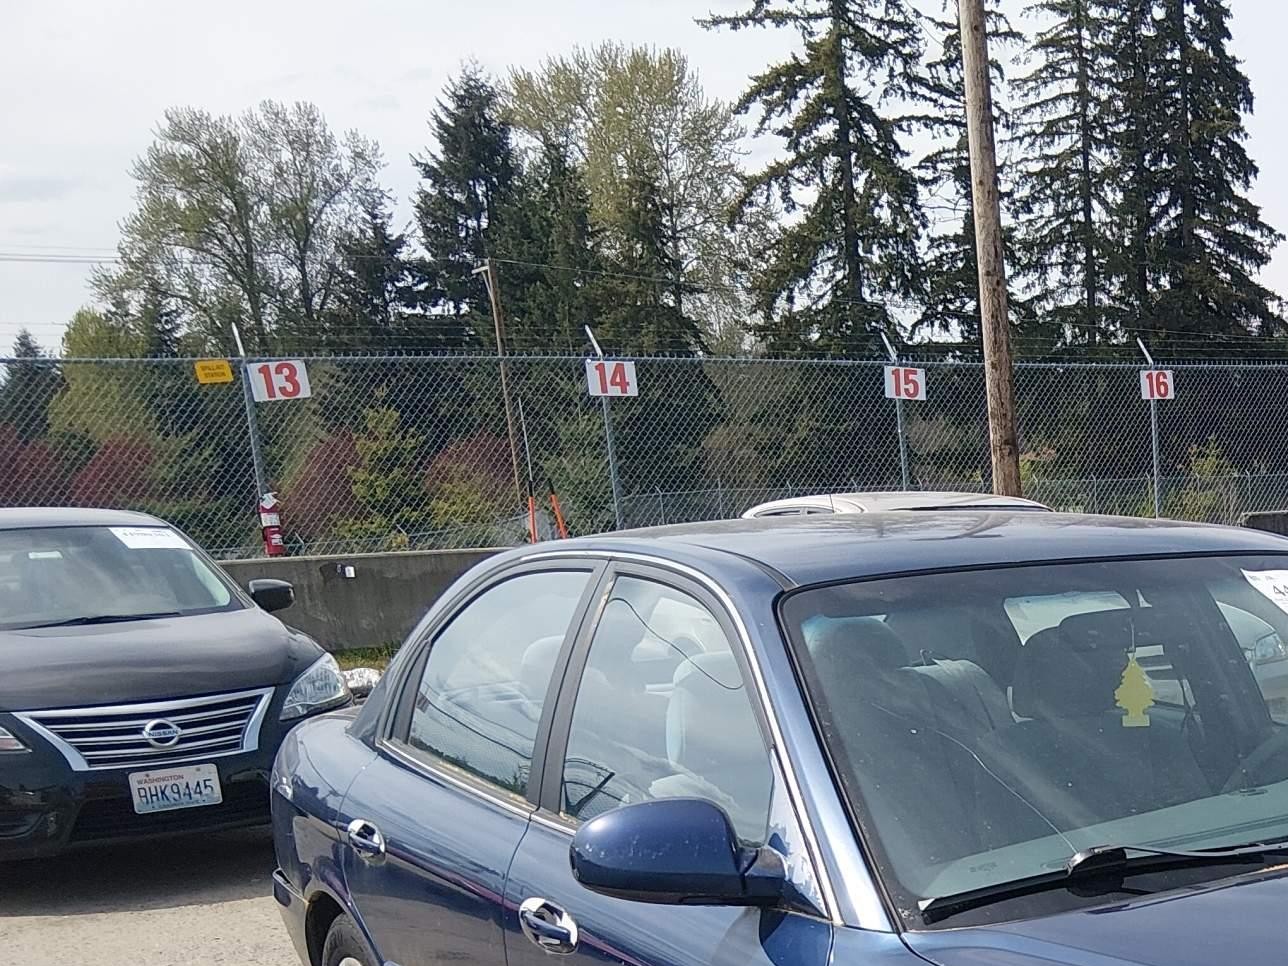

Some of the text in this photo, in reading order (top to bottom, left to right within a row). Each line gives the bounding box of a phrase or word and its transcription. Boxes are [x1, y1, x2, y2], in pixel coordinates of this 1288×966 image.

[258, 363, 300, 398] 13
[595, 363, 629, 394] 14
[892, 368, 919, 398] 15
[1146, 372, 1168, 398] 16
[148, 729, 179, 738] NISSAN
[137, 775, 184, 785] WASHINGTON
